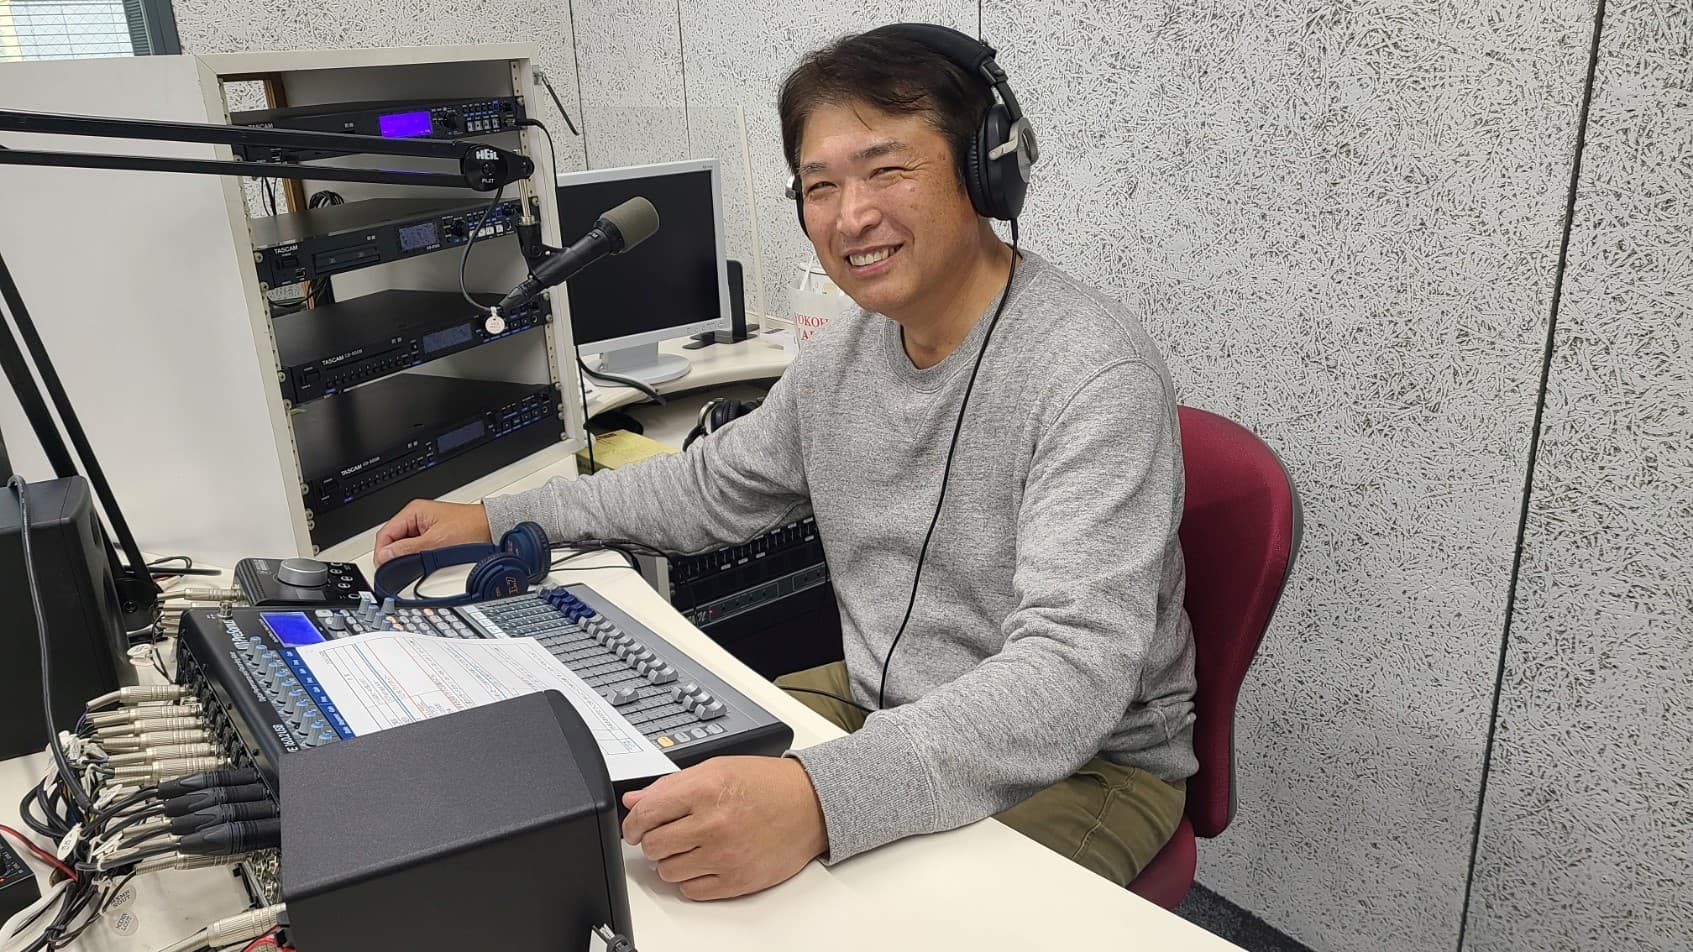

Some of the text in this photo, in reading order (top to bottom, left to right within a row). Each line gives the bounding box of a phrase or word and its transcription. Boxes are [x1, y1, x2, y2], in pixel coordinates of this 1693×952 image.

[273, 245, 298, 254] TASCAM
[321, 355, 344, 365] TASCAM
[341, 464, 363, 476] TASCAM
